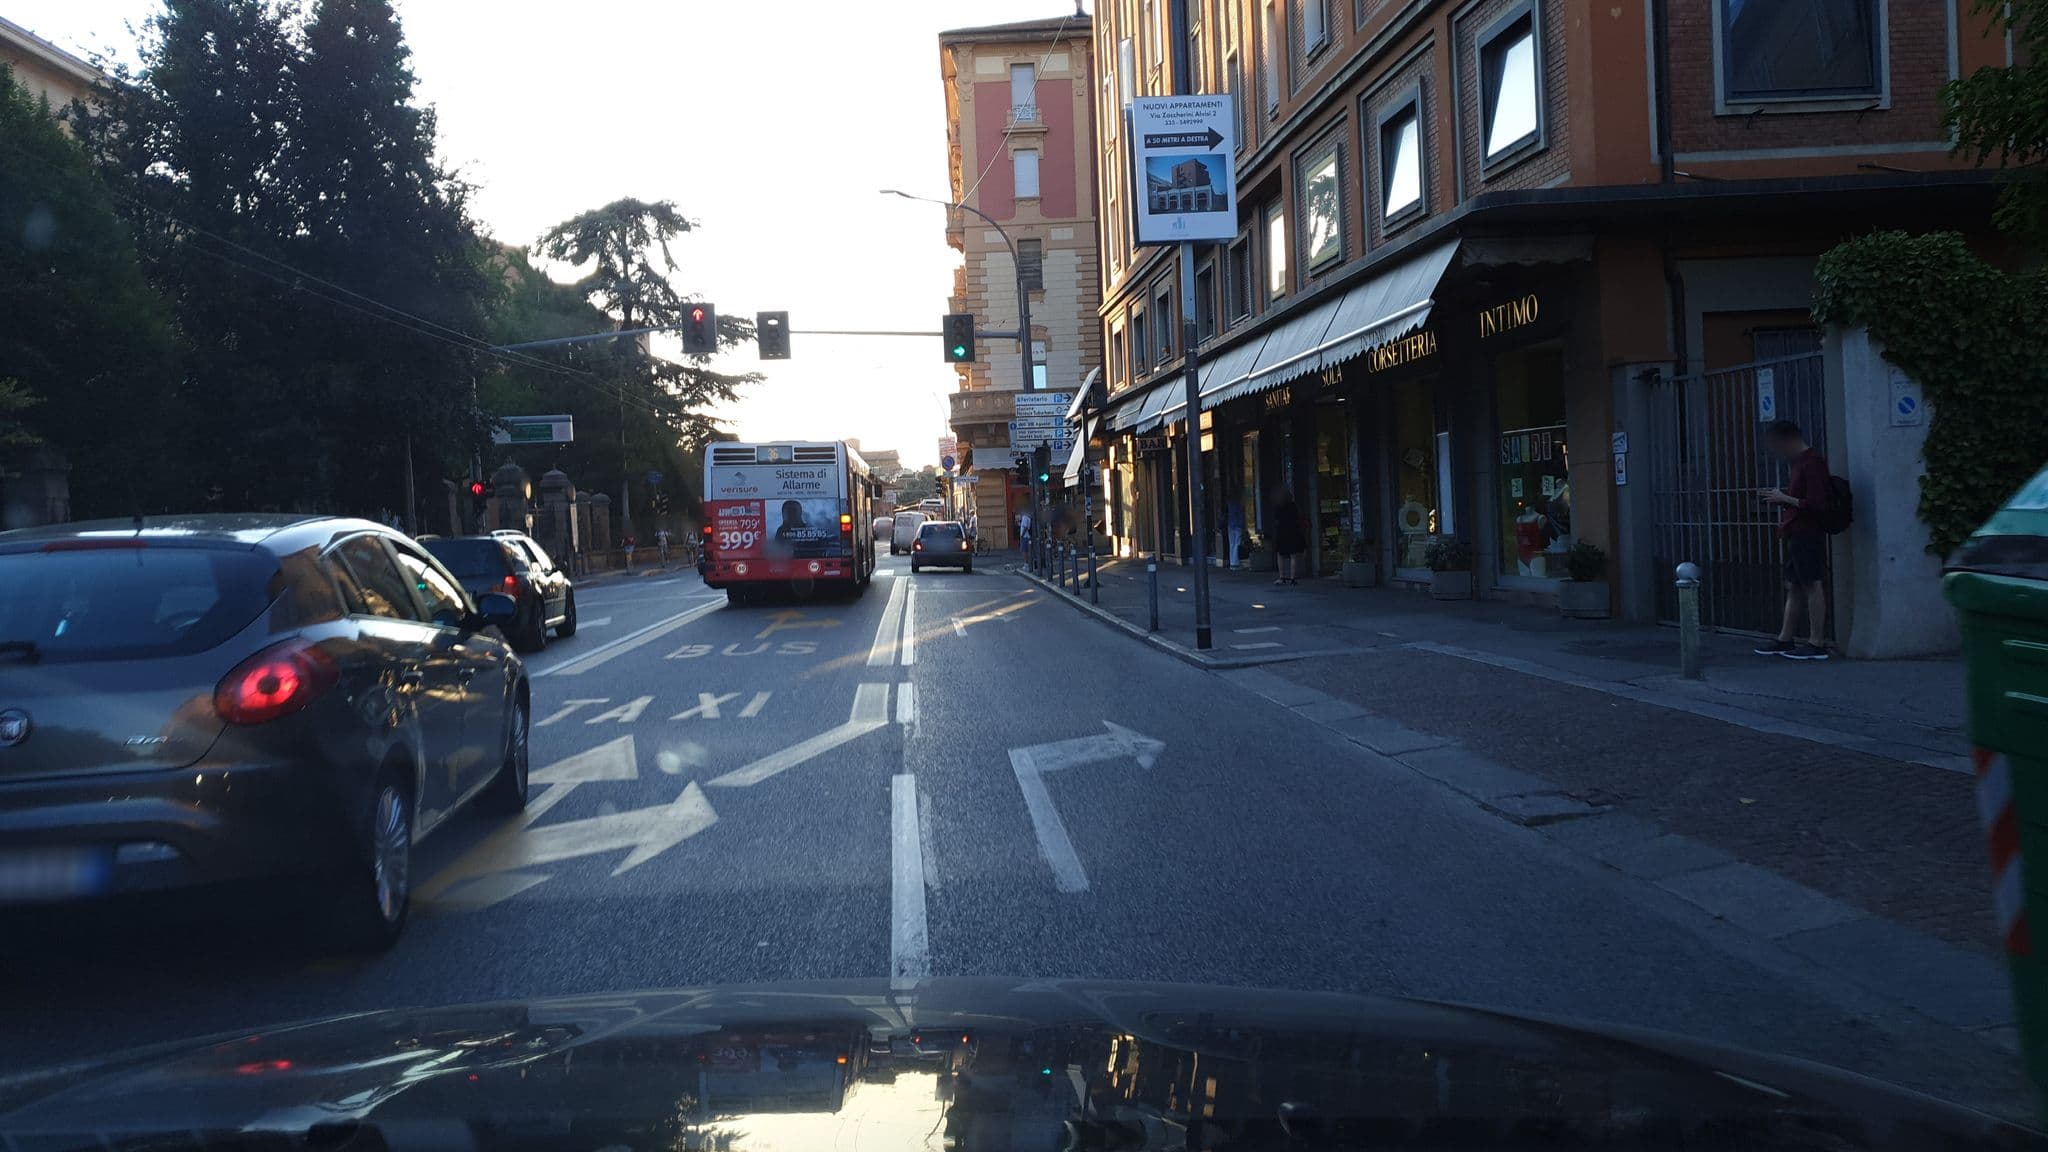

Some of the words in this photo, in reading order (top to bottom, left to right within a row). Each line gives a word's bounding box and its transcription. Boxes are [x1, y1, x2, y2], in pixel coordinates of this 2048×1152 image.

[1169, 101, 1223, 109] APPARTAMENTI
[1479, 293, 1540, 339] INTIMO
[1367, 329, 1438, 374] CORSETTERIA
[775, 469, 815, 479] Sistema
[817, 468, 827, 479] di
[782, 480, 821, 490] Allarme
[664, 641, 818, 660] BUS
[535, 690, 774, 727] TAXI
